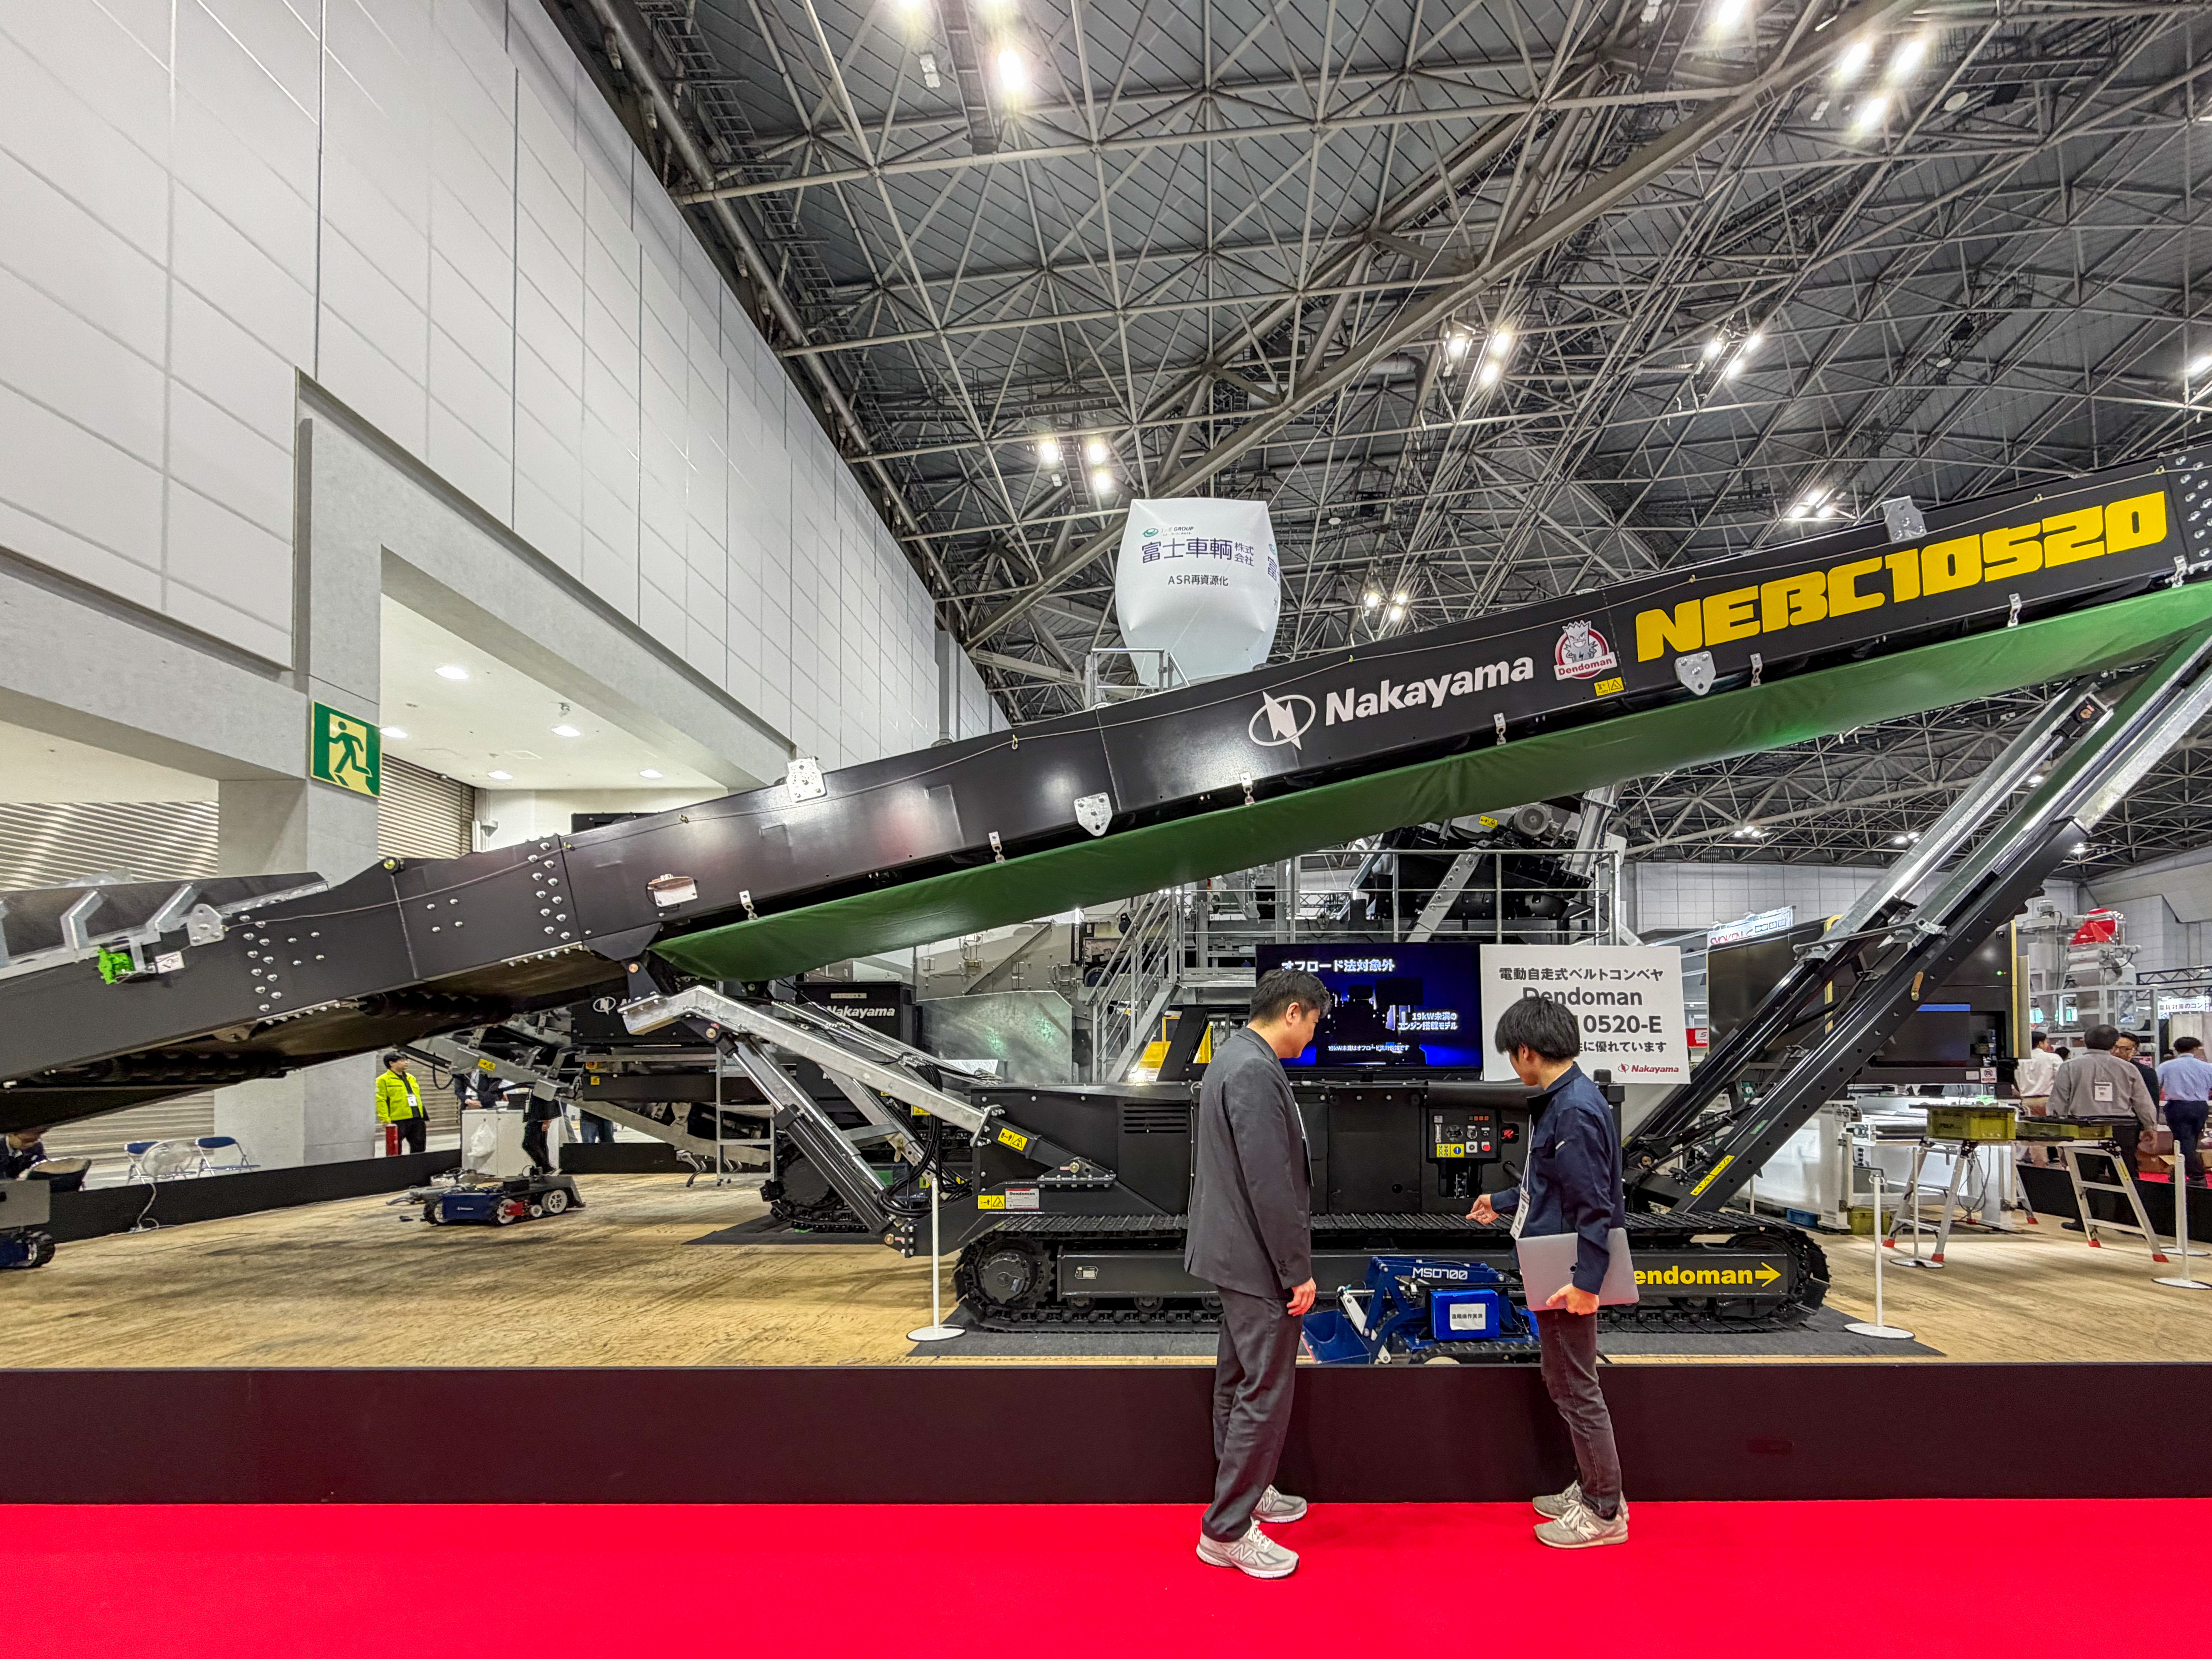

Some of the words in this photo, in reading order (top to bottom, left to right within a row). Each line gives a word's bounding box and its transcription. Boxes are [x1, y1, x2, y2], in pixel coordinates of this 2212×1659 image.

[1142, 537, 1233, 563] 富士車輌
[1636, 491, 2167, 663] NEBC10520
[1558, 658, 1613, 676] Dendoman
[1326, 656, 1534, 726] Nakayama
[1499, 968, 1663, 981] 電動自走式ベルトコンベヤ
[1631, 1065, 1679, 1074] Nakayama
[1413, 1267, 1468, 1280] MSD700
[1633, 1265, 1753, 1285] endoman
